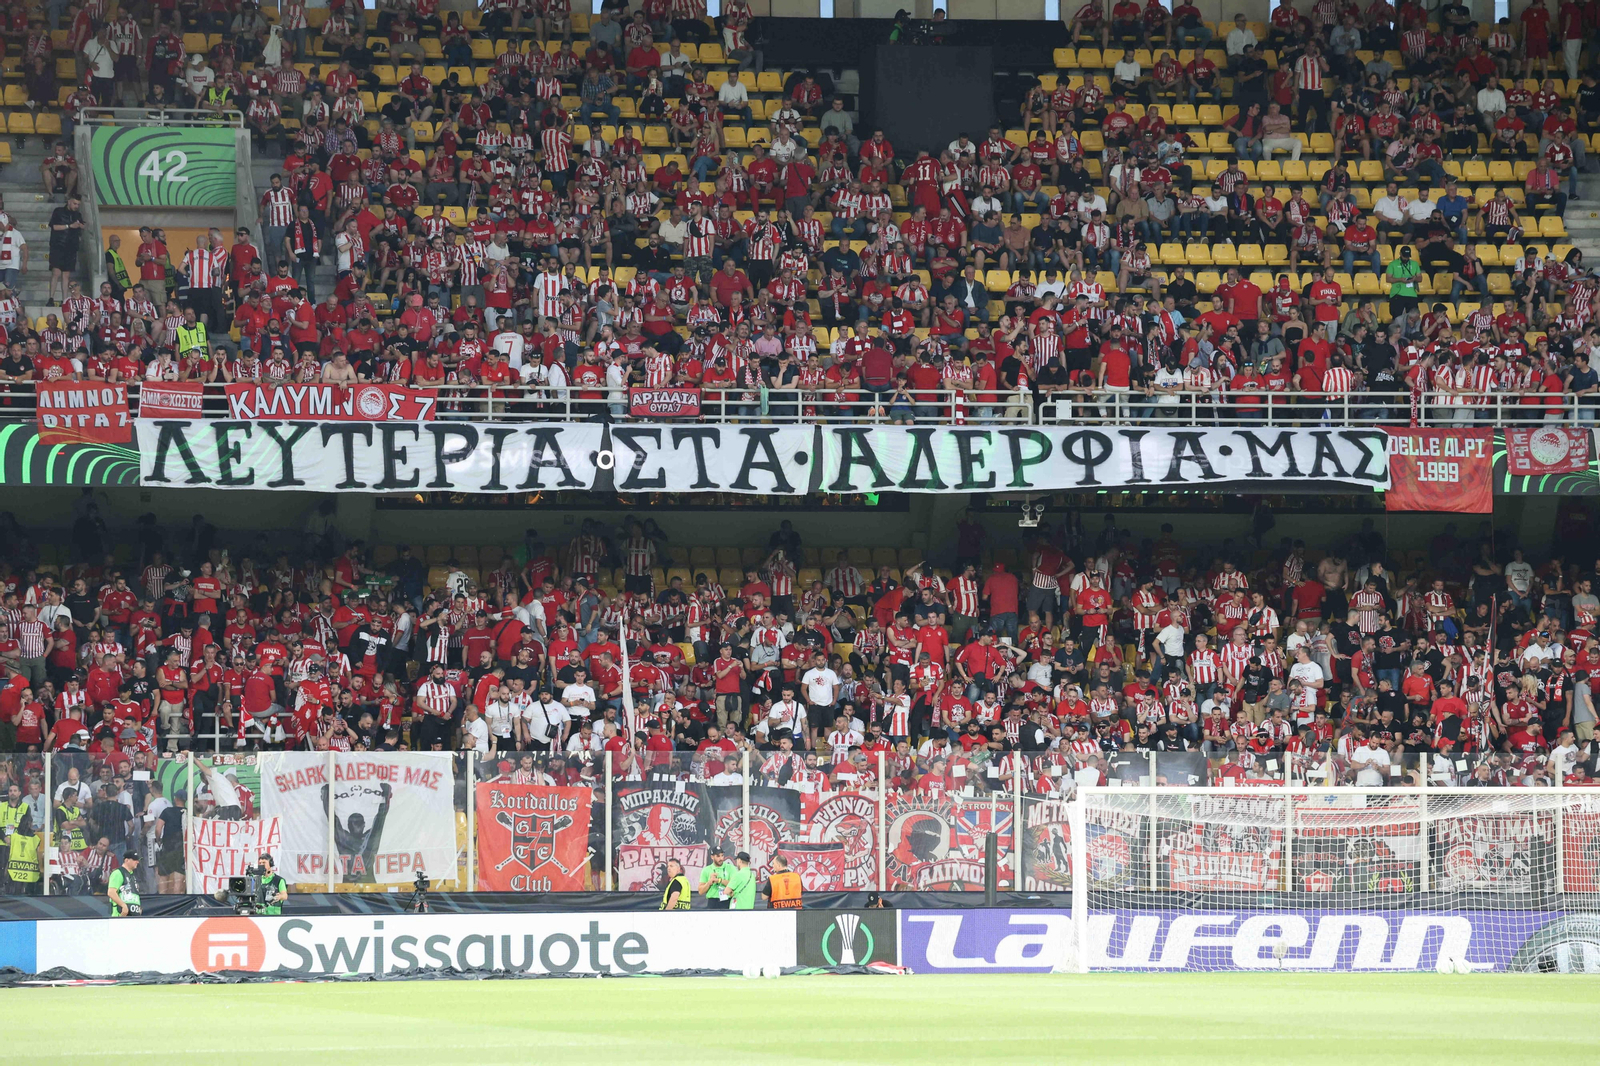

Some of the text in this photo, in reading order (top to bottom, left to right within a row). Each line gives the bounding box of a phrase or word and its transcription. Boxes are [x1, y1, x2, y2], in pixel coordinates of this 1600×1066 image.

[139, 150, 188, 181] 42
[918, 165, 931, 181] 11
[1320, 288, 1336, 296] FINAL
[505, 341, 513, 355] 7
[40, 387, 125, 408] ΛΗΜΝΟΣ
[632, 391, 698, 406] ΑΡΙΔΑΙΑ
[650, 403, 681, 412] ΘΥΡΑ 7
[414, 397, 434, 420] 7
[115, 412, 127, 427] 7
[144, 420, 586, 491] ΛΕΥΤΕΡΙΑ
[611, 427, 796, 493] ΣΤΑ
[828, 427, 1227, 491] ΑΔΕΡΦΙΑ
[1233, 430, 1389, 482] ΜΑΣ
[1389, 436, 1486, 458] DELLE ALPI
[1417, 461, 1459, 482] 1999
[274, 763, 443, 793] SHARK ΑΔΕΡΦΕ ΜΑΣ
[490, 790, 579, 811] Koridallos
[297, 852, 426, 876] ΚΡΑΤΑ ΓΕΡΑ
[621, 847, 707, 869] PATRA
[13, 871, 28, 880] 722
[510, 874, 552, 892] Club
[277, 919, 648, 974] Swissquote
[907, 914, 1495, 969] Laufenn
